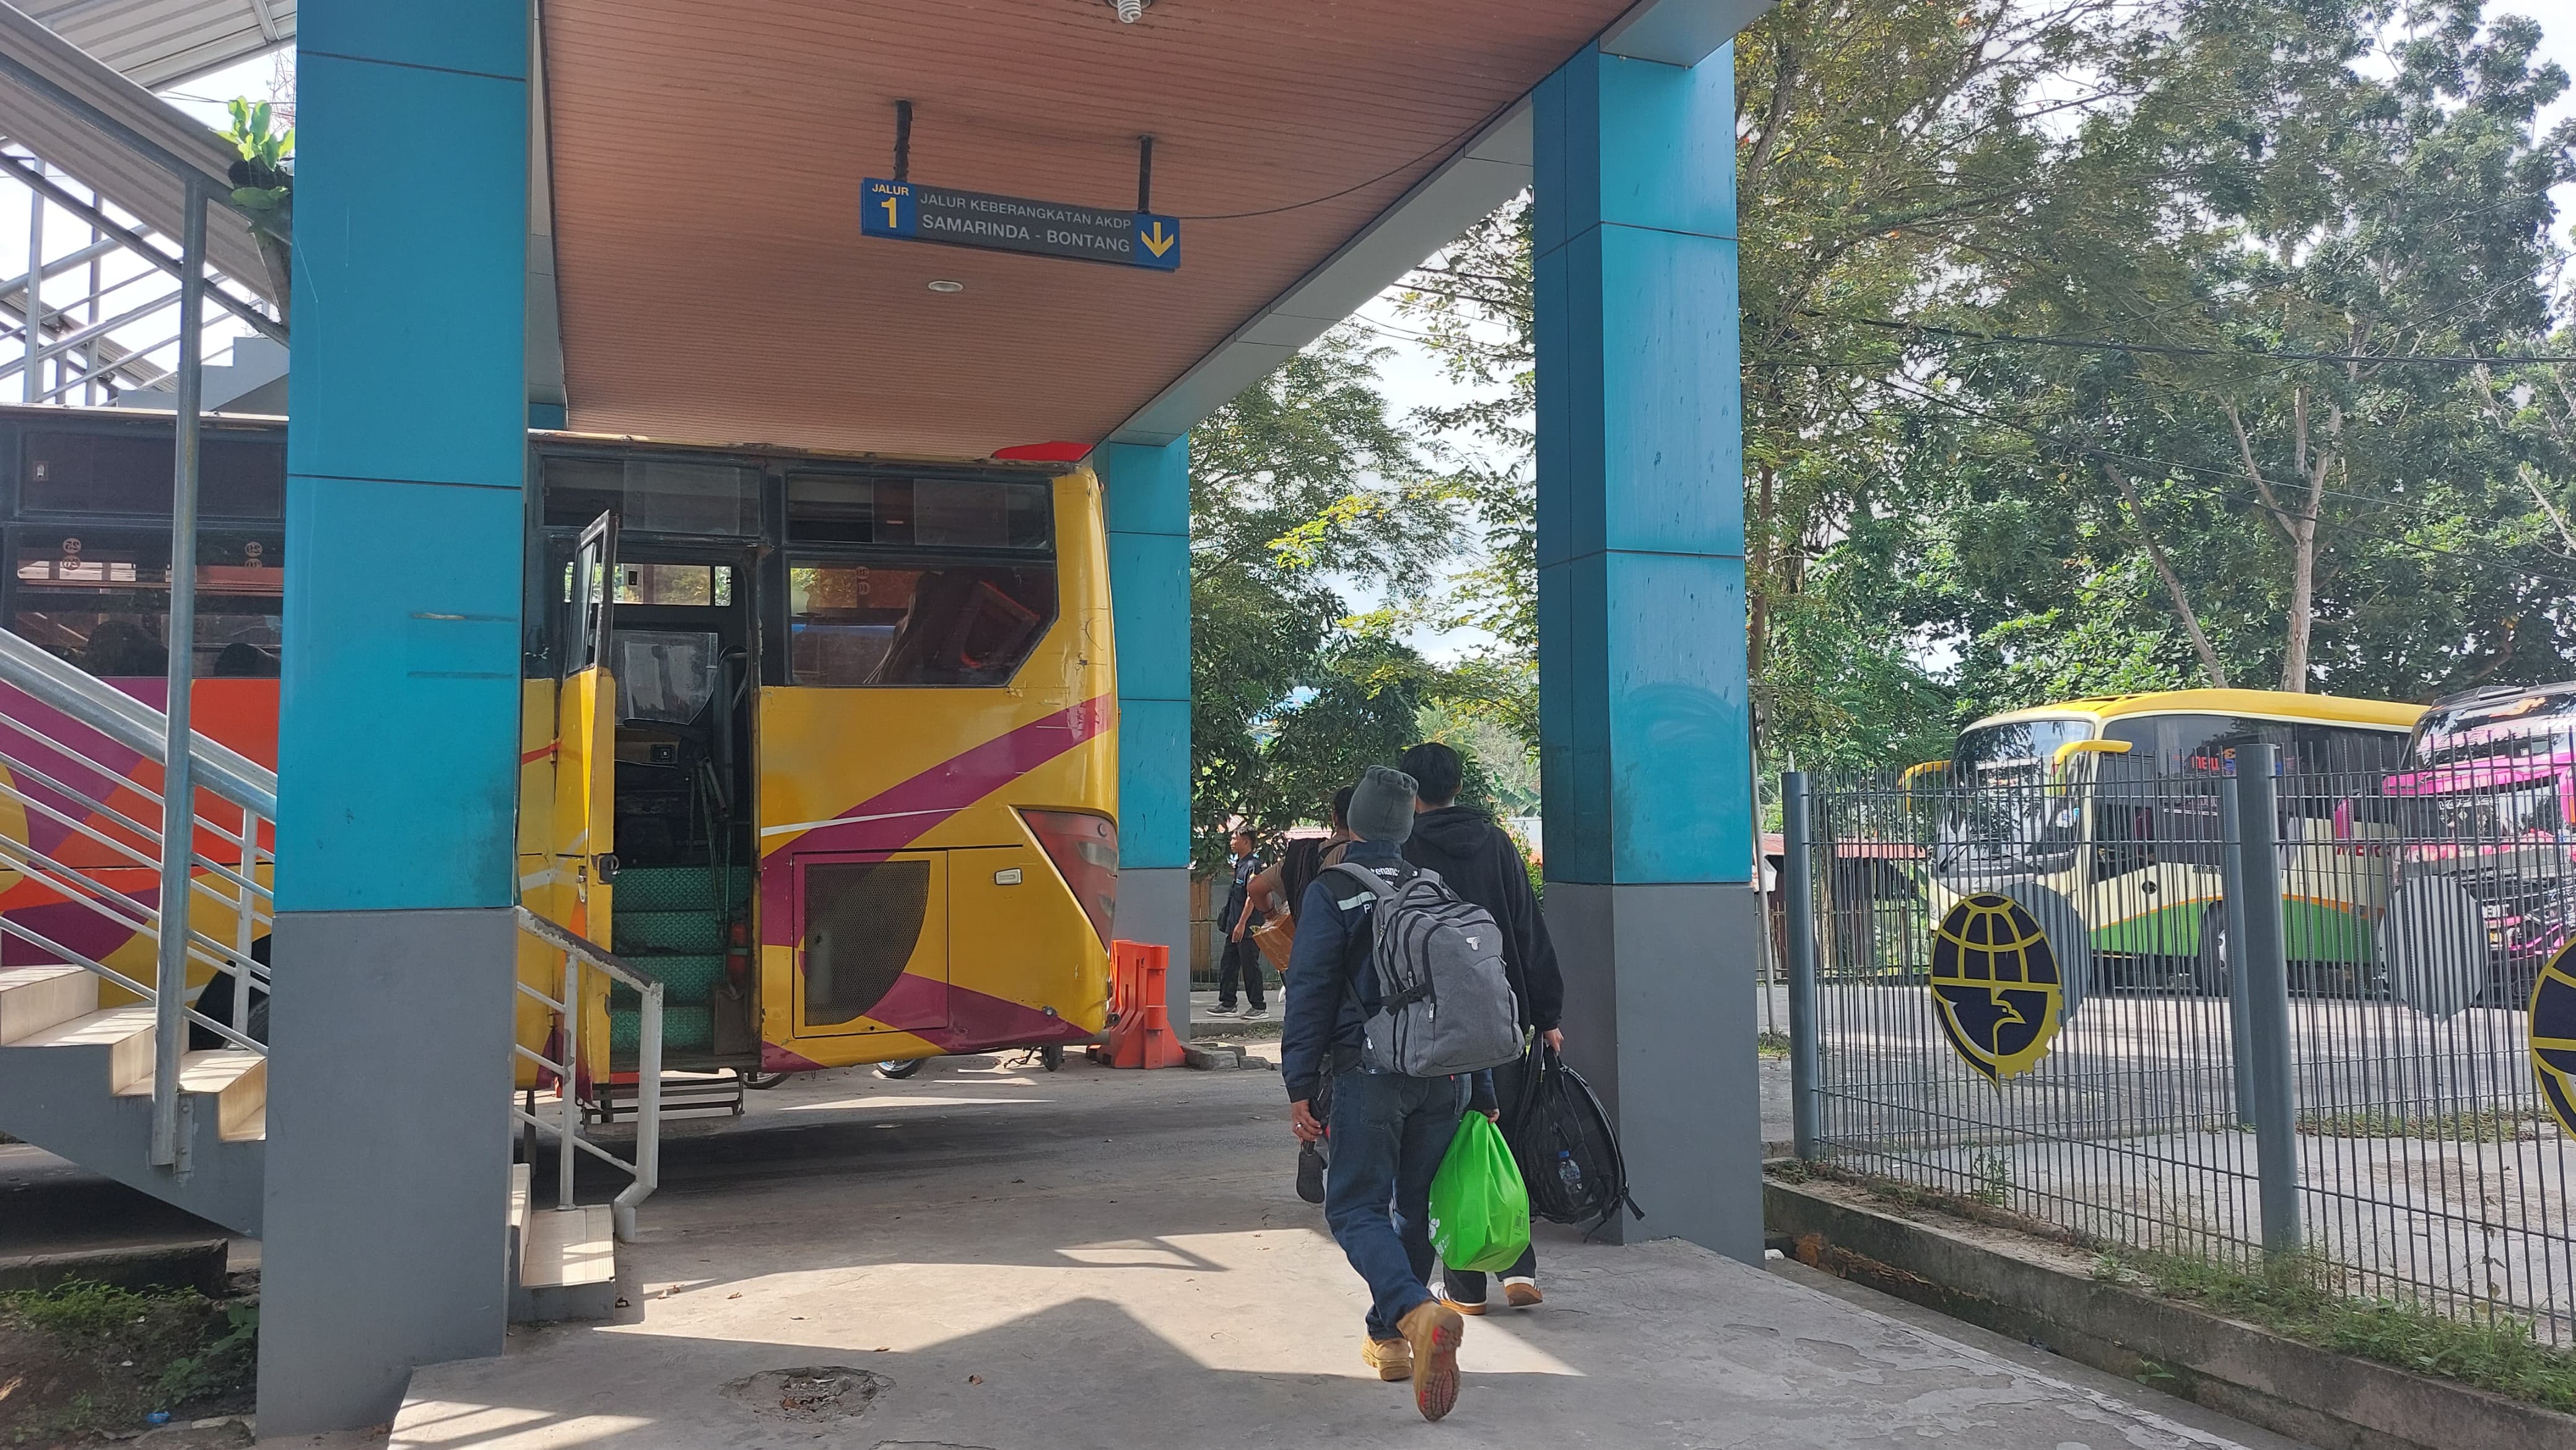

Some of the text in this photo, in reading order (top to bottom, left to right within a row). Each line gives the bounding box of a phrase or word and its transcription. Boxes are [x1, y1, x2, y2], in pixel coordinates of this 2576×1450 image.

[872, 183, 909, 196] JALUR
[881, 197, 897, 228] 1
[920, 193, 1131, 230] JALUR KEBERANGKATAN AKDP
[922, 214, 1030, 240] SAMARINDA
[1047, 230, 1130, 253] BONTANG
